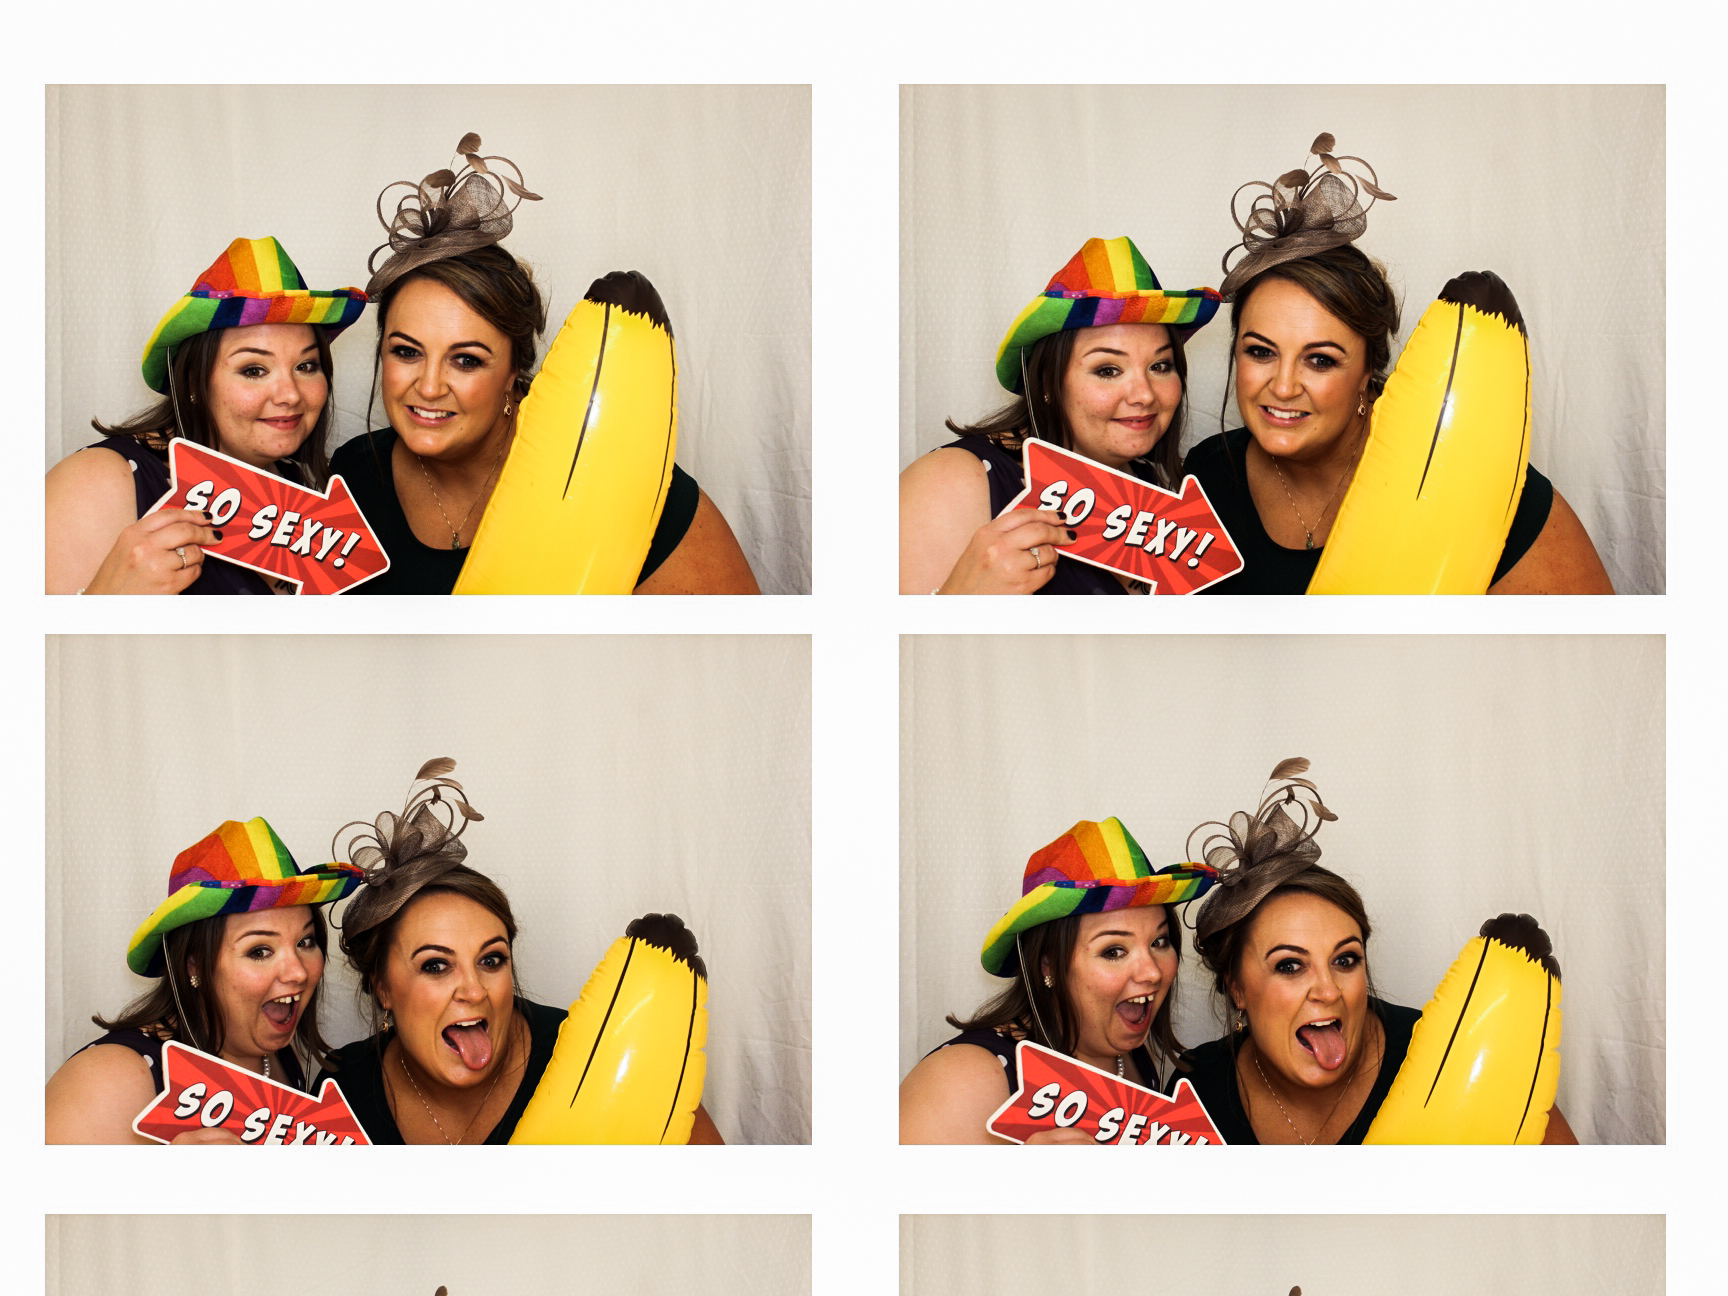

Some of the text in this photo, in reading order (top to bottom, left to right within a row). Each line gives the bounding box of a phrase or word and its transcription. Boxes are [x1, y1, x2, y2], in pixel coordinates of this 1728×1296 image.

[185, 480, 361, 570] SO SEXY!
[1039, 480, 1215, 570] SO SEXY!
[174, 1082, 234, 1128] SO
[1028, 1082, 1088, 1128] SO
